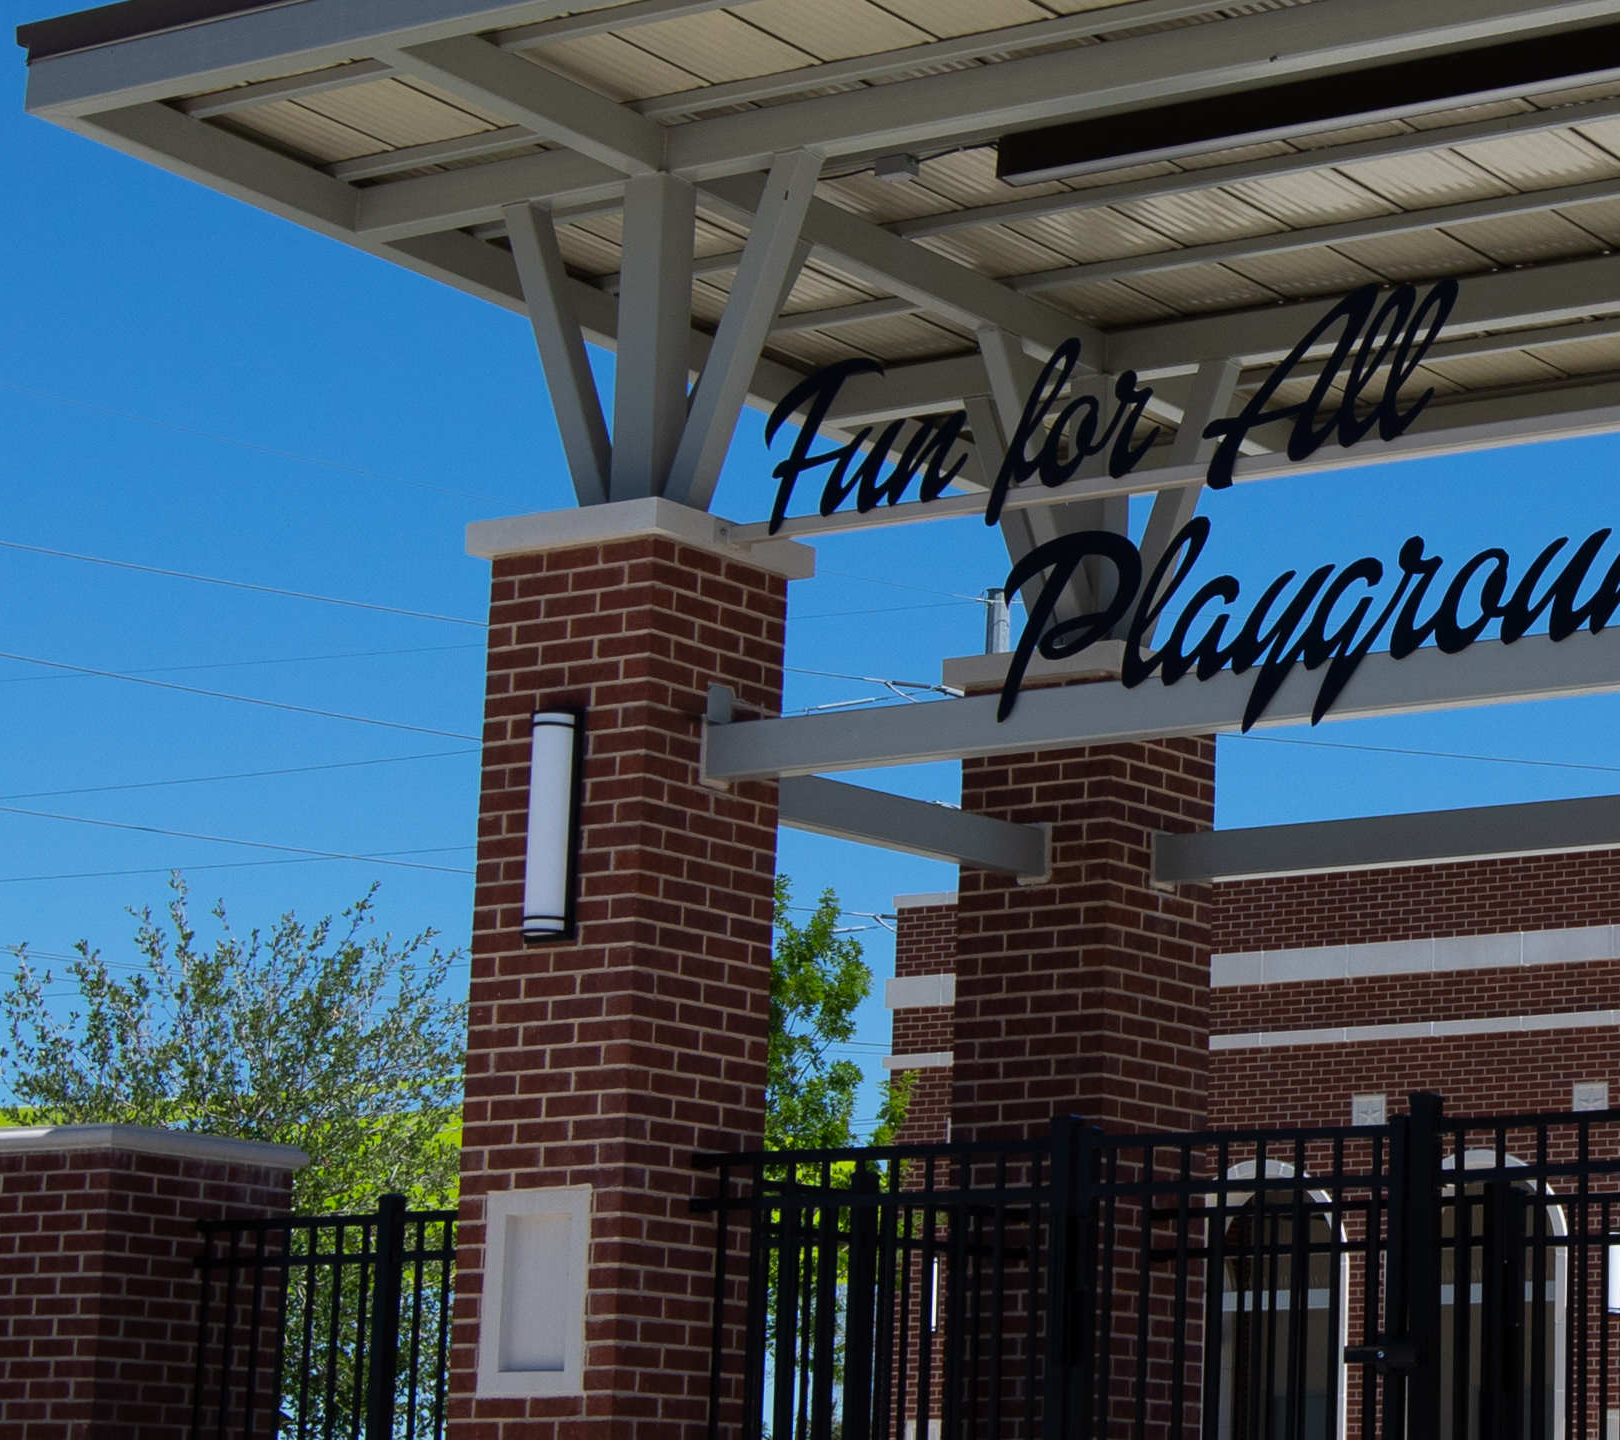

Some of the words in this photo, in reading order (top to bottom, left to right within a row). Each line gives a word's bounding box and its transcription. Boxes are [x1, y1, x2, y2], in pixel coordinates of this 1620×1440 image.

[765, 358, 968, 536] Fun
[985, 337, 1160, 526] for
[1202, 279, 1459, 490] All
